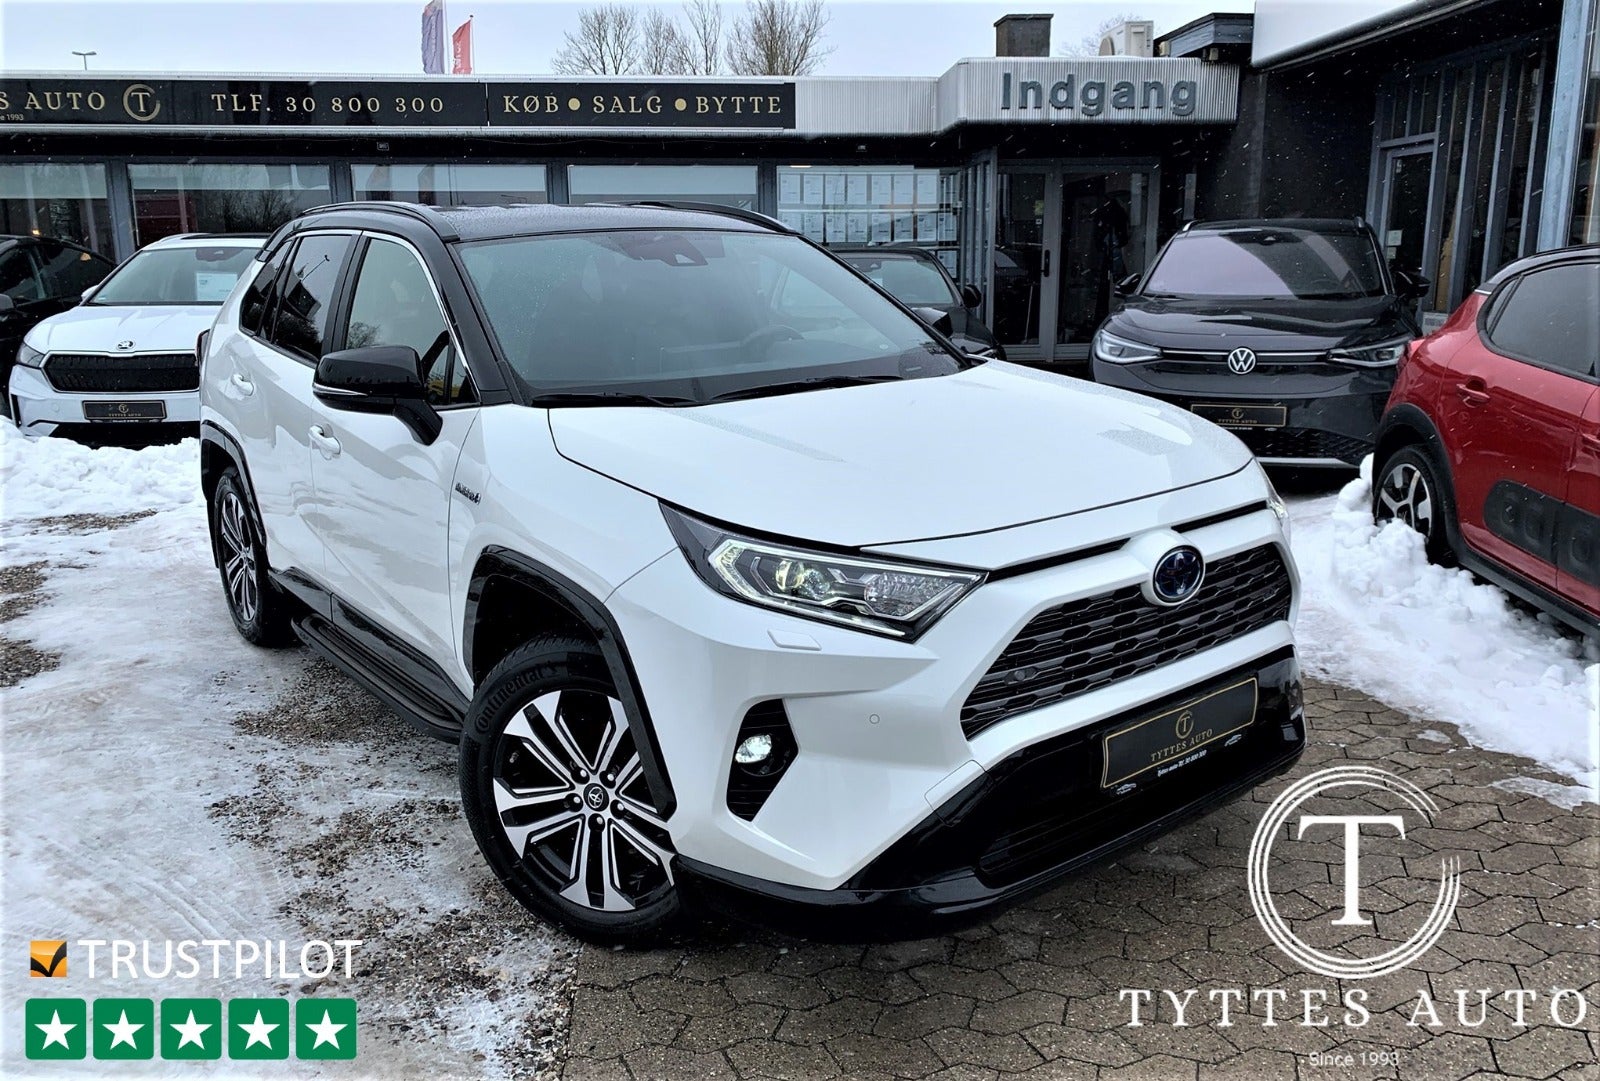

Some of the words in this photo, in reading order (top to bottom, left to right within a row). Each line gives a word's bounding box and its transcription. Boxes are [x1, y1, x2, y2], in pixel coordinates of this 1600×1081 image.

[24, 91, 105, 110] AUTO
[211, 93, 271, 113] TLF.
[286, 97, 316, 112] 30
[331, 97, 380, 113] 800
[395, 98, 443, 113] 300
[503, 94, 559, 114] KØB
[592, 95, 663, 114] SALG
[695, 96, 781, 114] BYTTE
[1001, 72, 1198, 117] Indgang
[1151, 741, 1187, 762] TYTTES
[1190, 728, 1213, 746] AUTO
